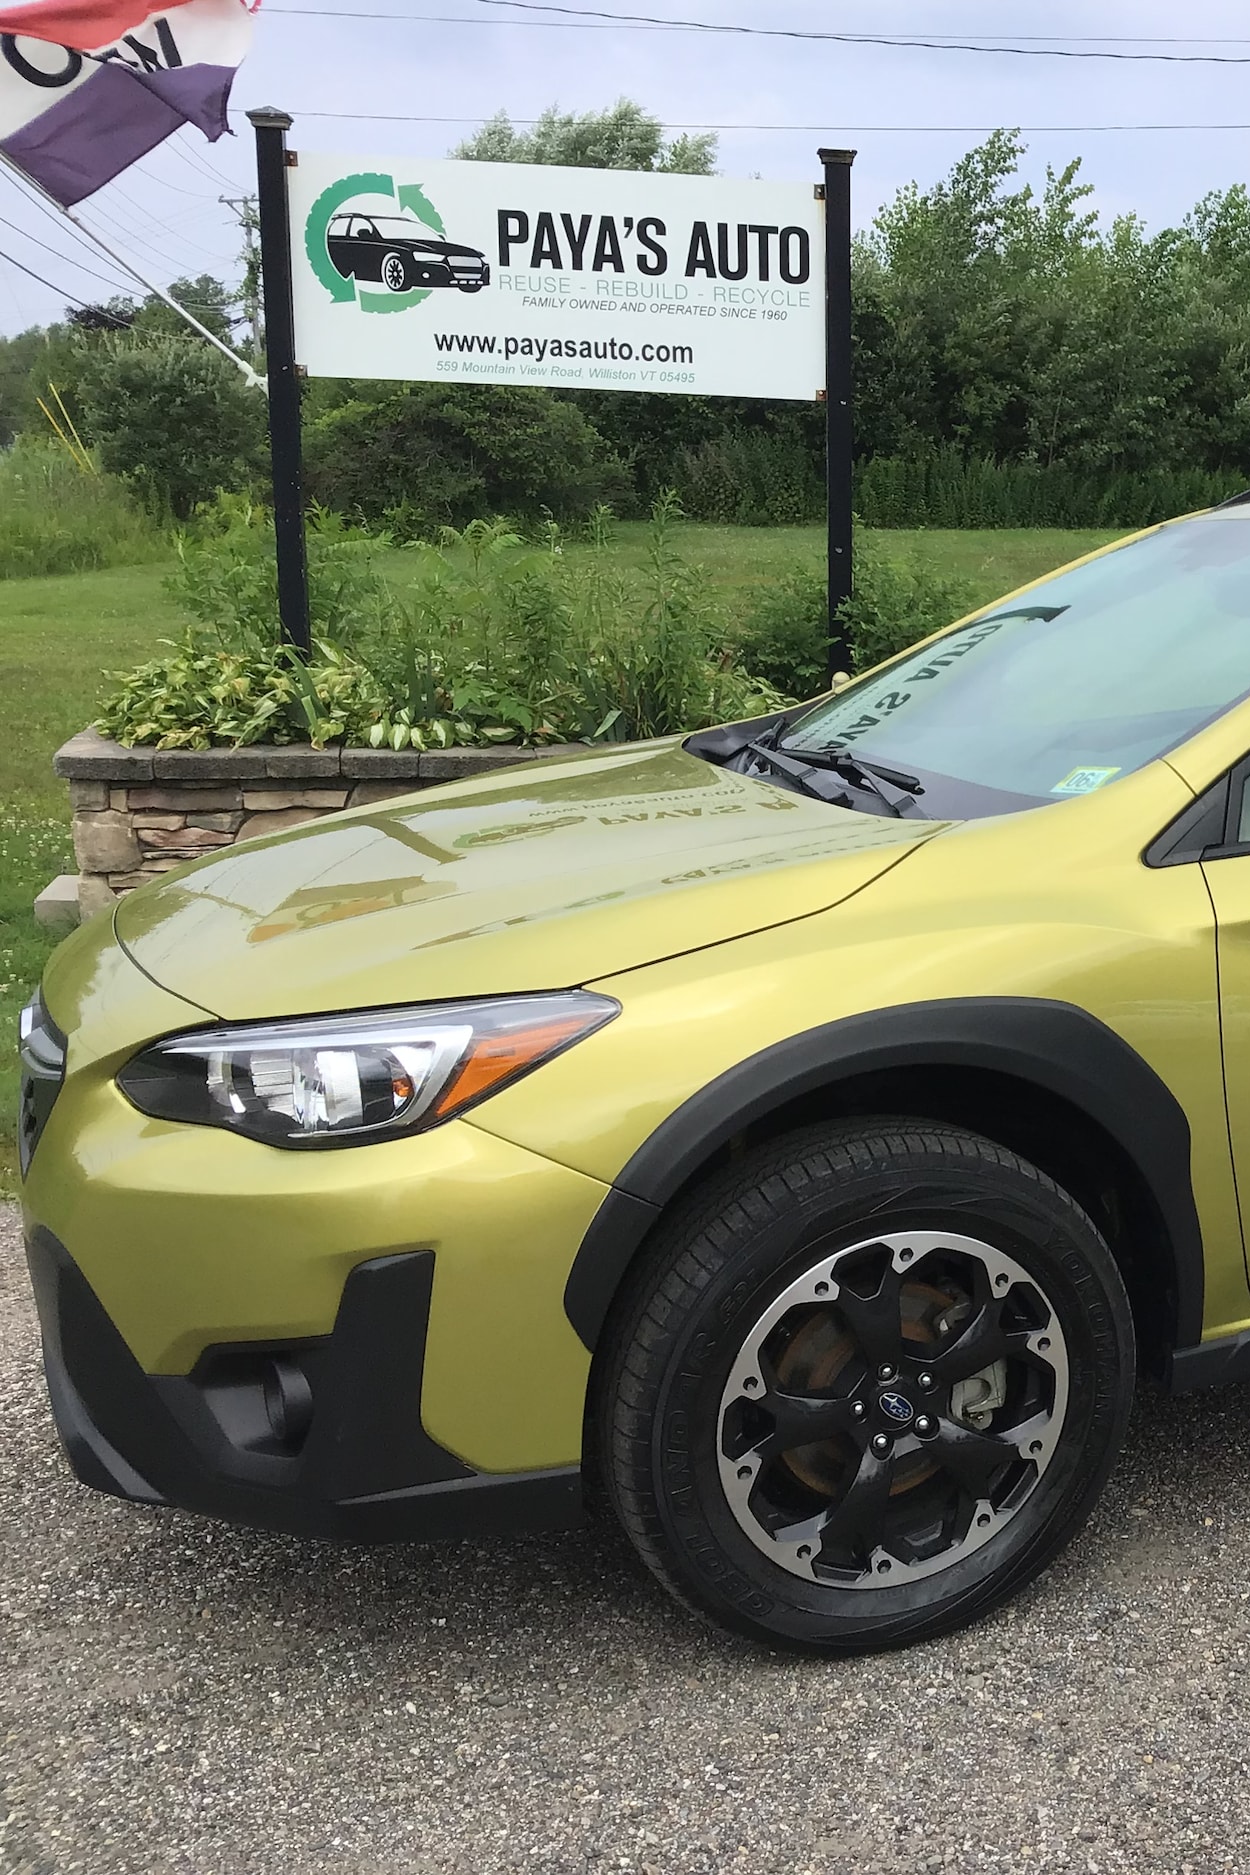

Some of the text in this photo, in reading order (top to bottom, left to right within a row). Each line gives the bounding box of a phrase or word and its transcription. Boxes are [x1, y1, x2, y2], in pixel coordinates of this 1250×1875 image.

[498, 208, 810, 285] PAYA'S AUTO
[499, 274, 571, 293] REUSE
[597, 279, 689, 300] REBUILD
[713, 286, 811, 308] RECYCLE
[522, 296, 788, 321] FAMILY OWNED AND OPERATED SINCE 1960
[434, 333, 694, 364] www.payasauto.com
[436, 360, 459, 372] 559
[462, 361, 516, 375] Mountain
[520, 364, 548, 376] View
[588, 367, 637, 381] Williston
[641, 370, 658, 381] VT
[659, 371, 696, 383] 05495
